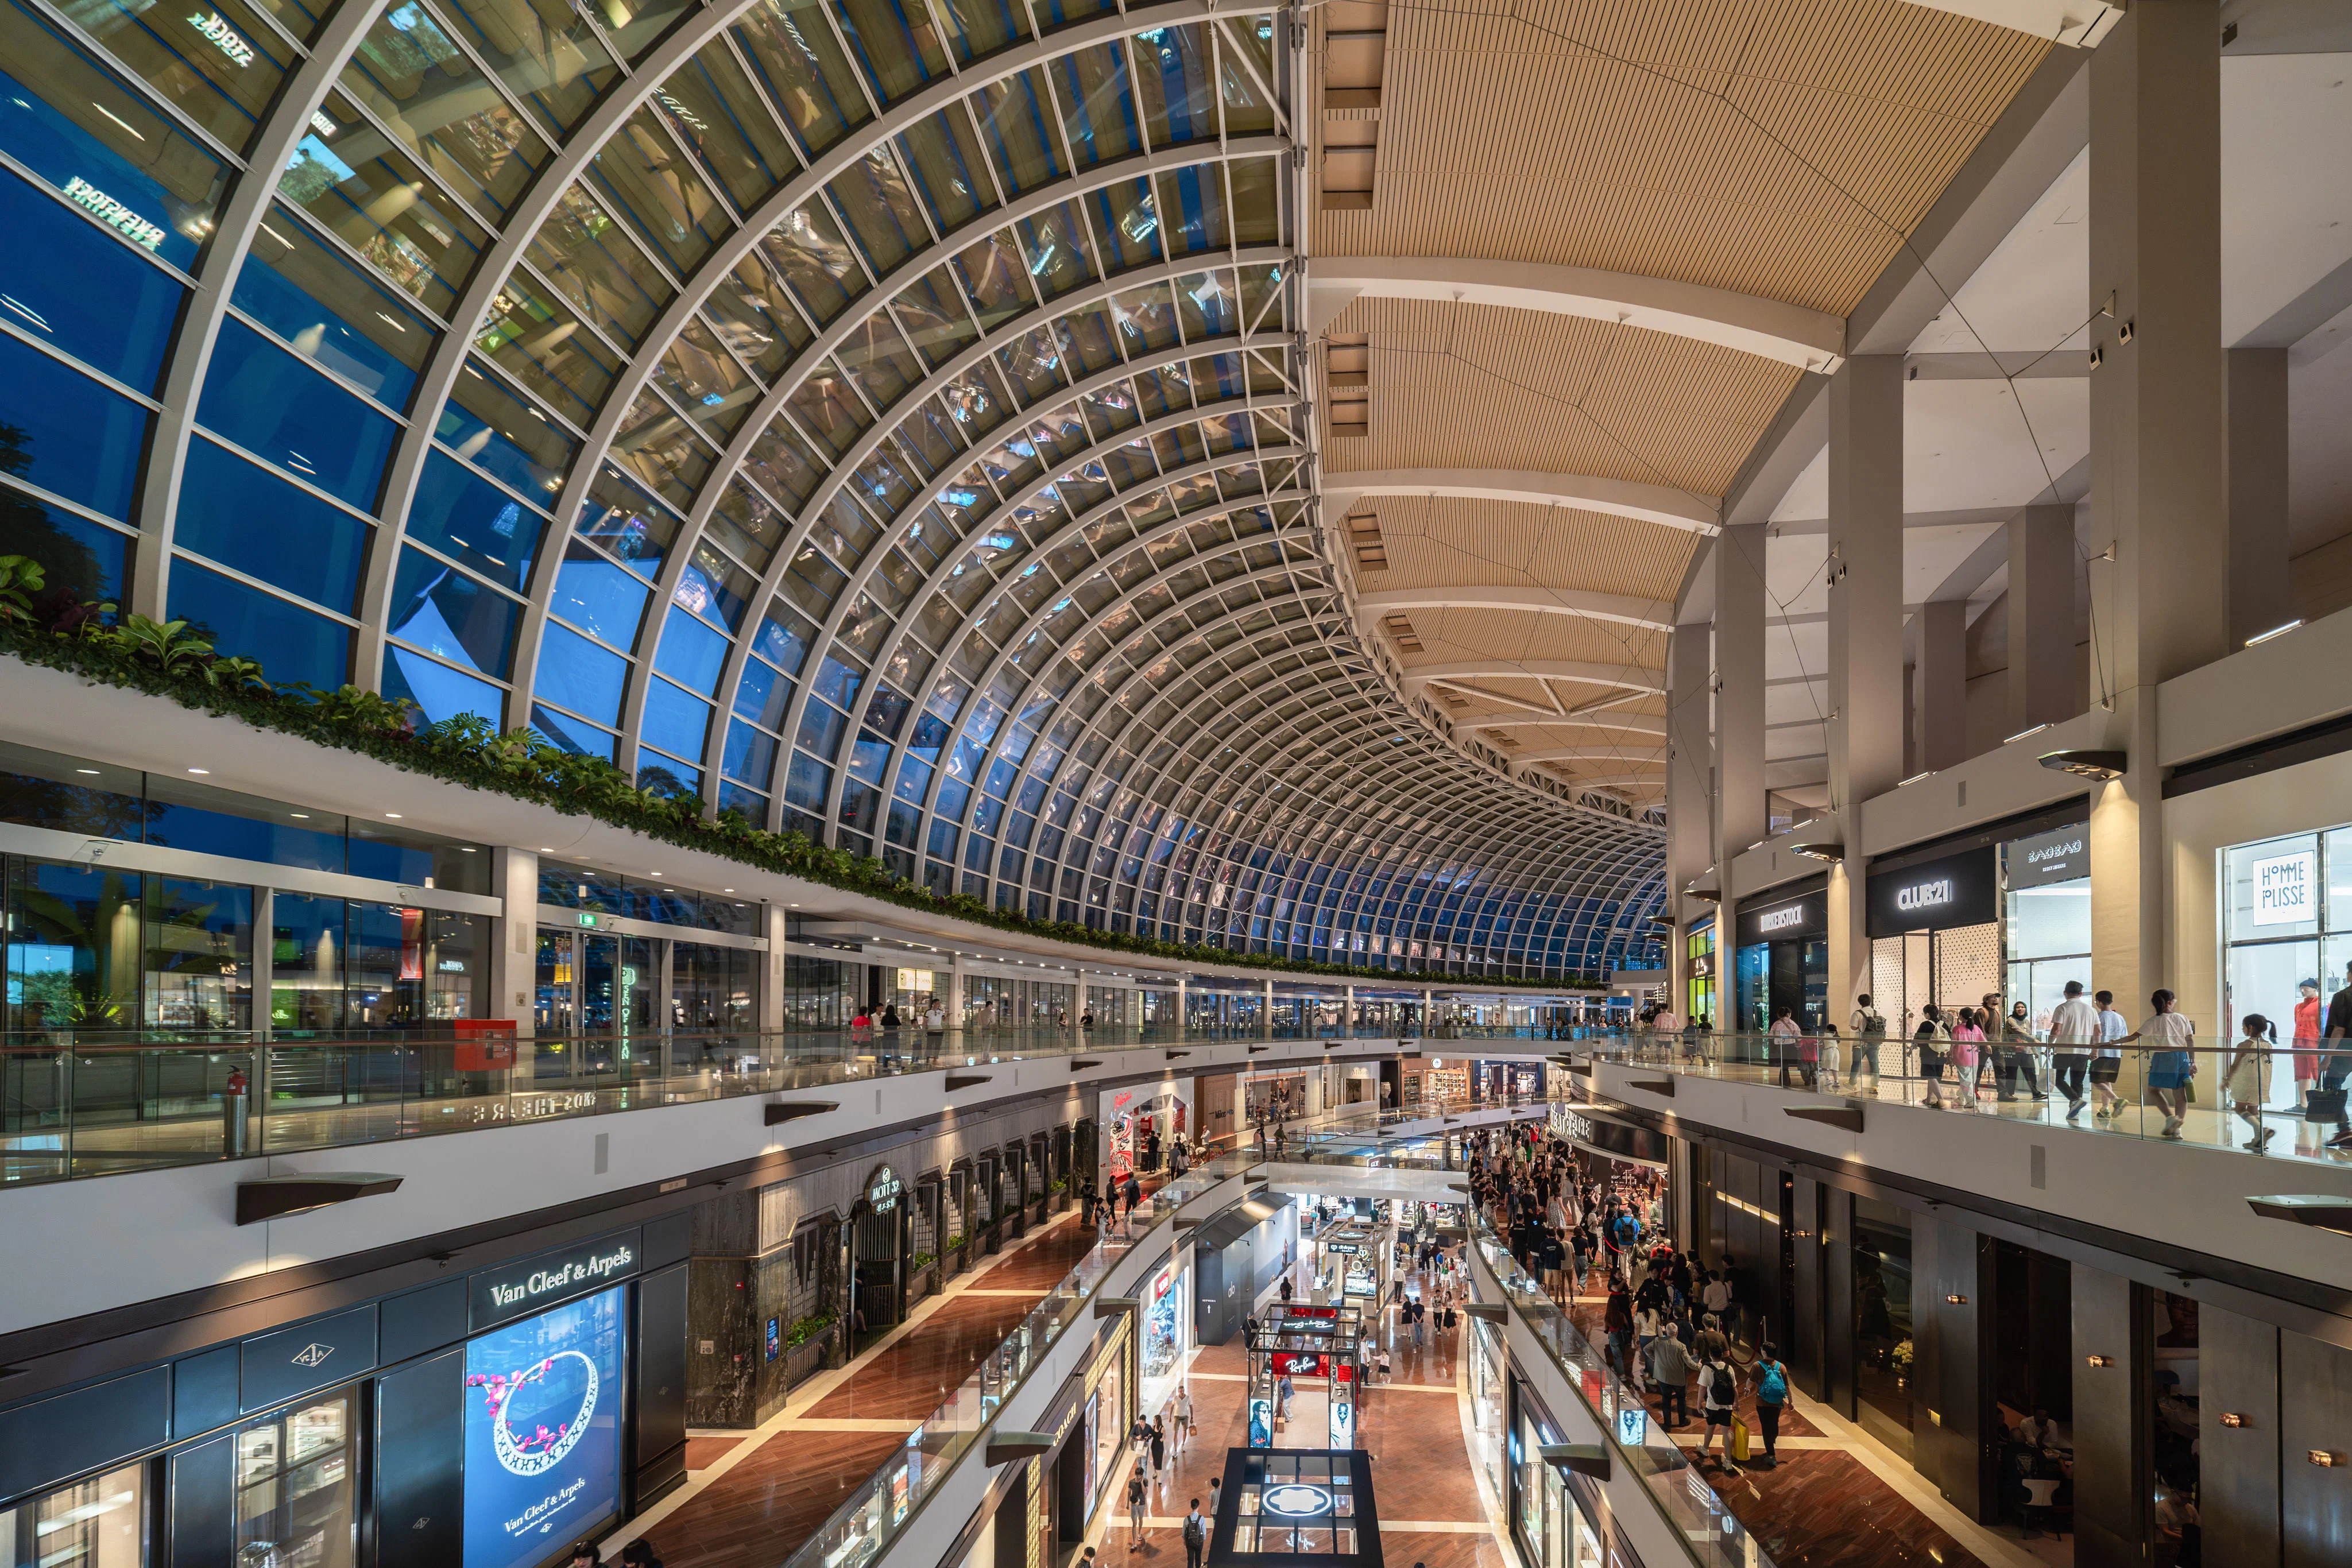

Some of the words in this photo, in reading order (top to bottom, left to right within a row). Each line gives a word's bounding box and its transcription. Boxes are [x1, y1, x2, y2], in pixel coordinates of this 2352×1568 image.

[1898, 880, 1950, 910] CLUB21
[1761, 905, 1802, 932] BIRKENSTOCK
[621, 985, 630, 1005] SEN
[872, 1183, 891, 1201] MOTT
[891, 1180, 899, 1193] 32
[491, 1284, 525, 1306] Van
[528, 1264, 572, 1294] Cleef
[574, 1265, 586, 1280] &
[587, 1247, 630, 1276] Arpels
[1053, 1401, 1076, 1446] COACH
[504, 1519, 523, 1532] Van
[524, 1497, 550, 1520] Cleef
[550, 1496, 558, 1505] &
[559, 1477, 585, 1501] Arpels
